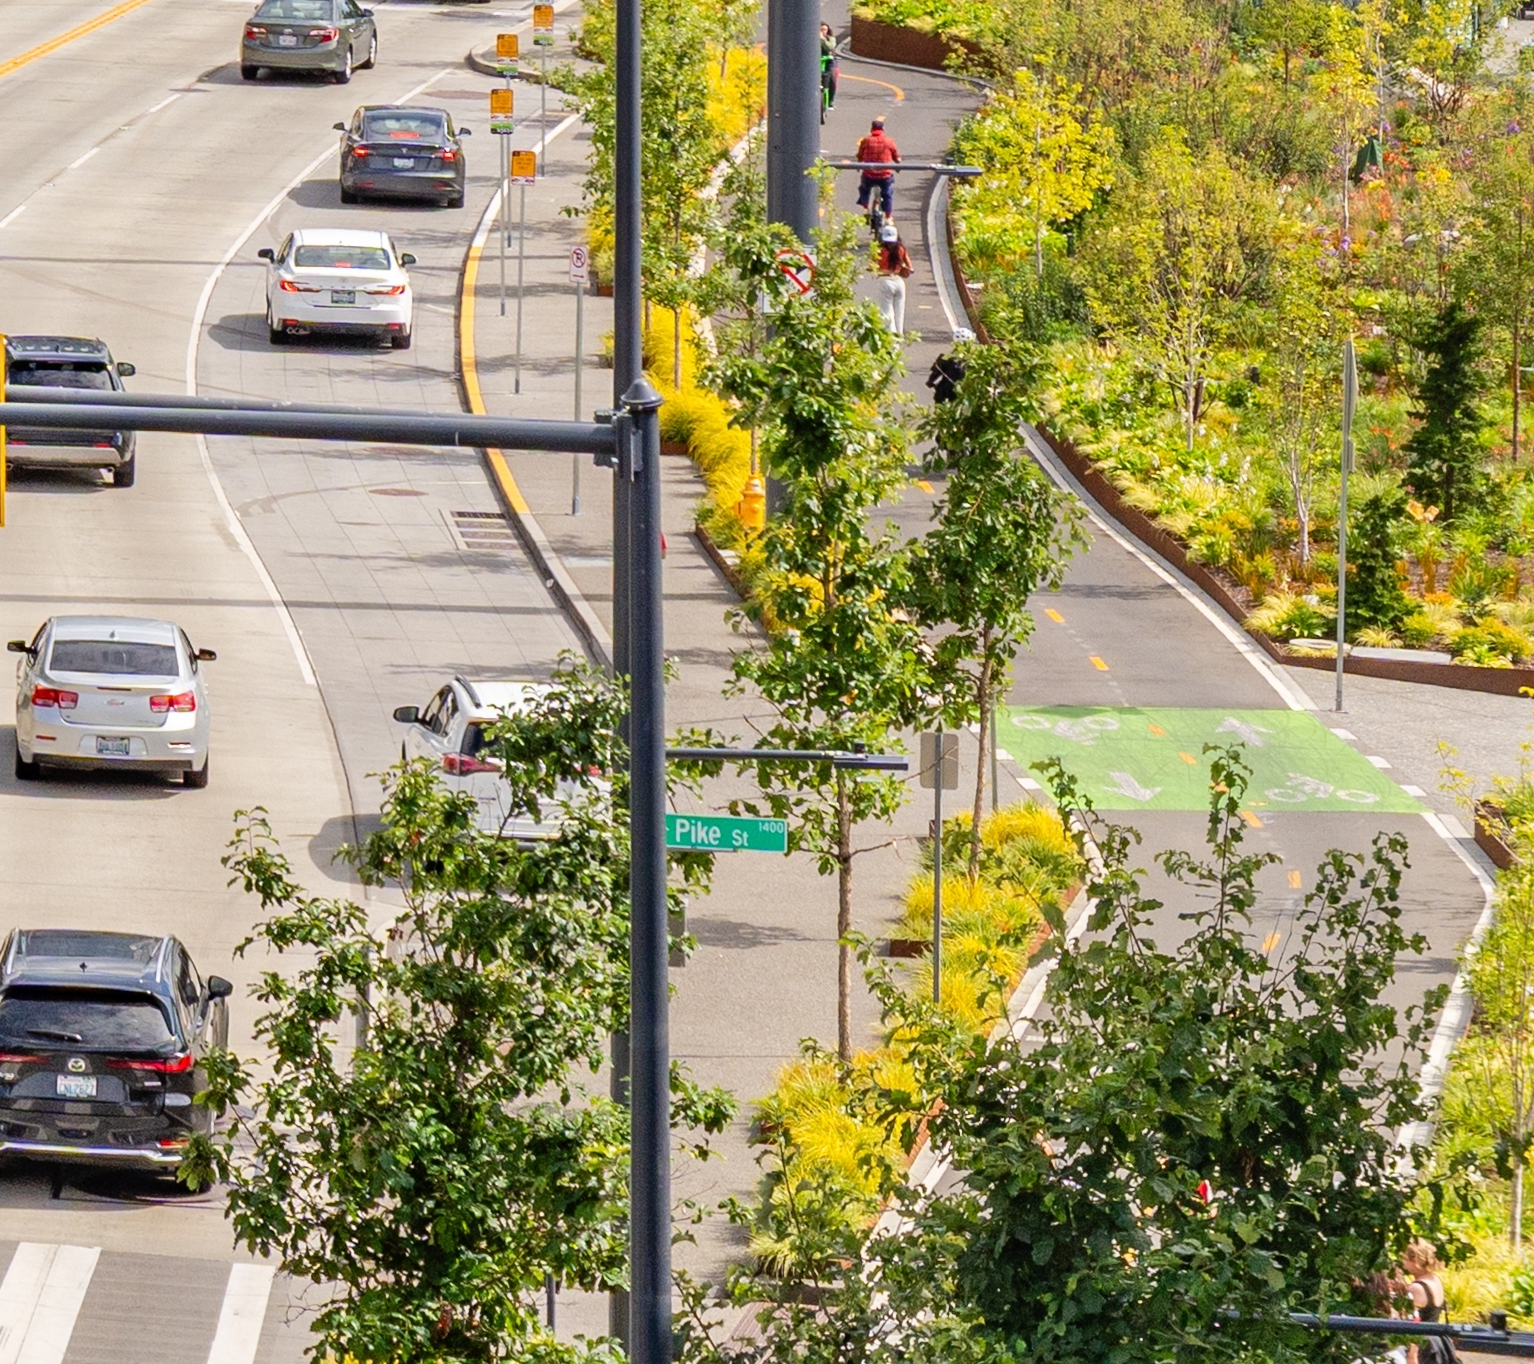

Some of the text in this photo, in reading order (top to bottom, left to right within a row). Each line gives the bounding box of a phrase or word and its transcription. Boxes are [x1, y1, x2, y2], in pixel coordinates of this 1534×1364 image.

[675, 818, 749, 846] Pike St
[758, 821, 784, 833] 1400
